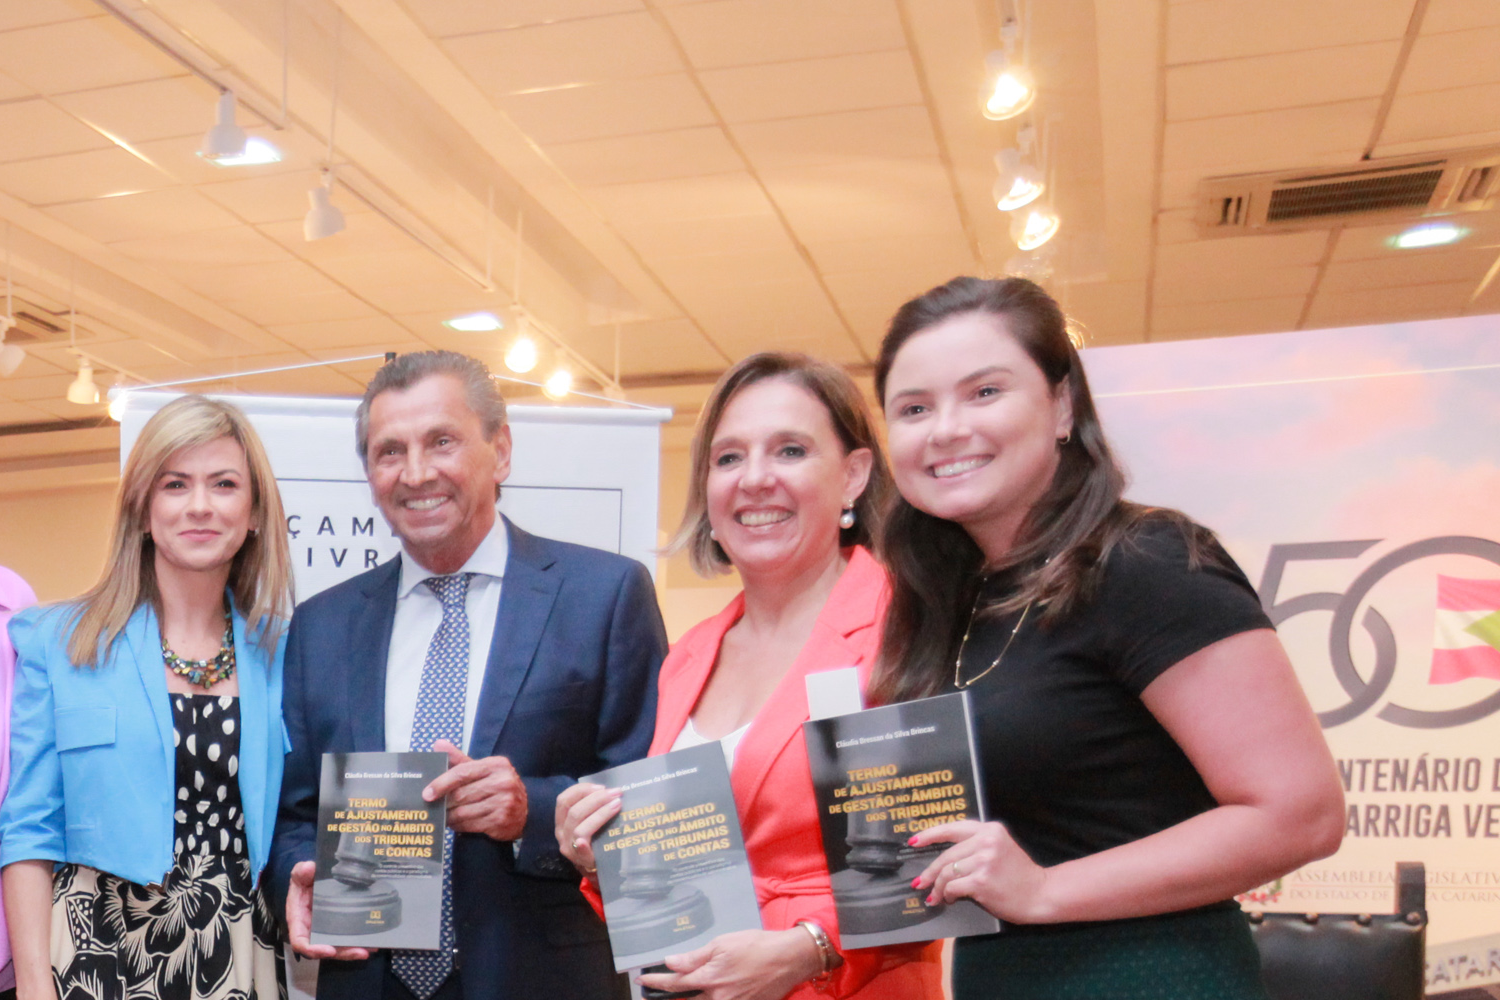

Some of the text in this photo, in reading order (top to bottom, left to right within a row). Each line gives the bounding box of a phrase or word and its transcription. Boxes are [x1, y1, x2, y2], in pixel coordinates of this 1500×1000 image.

[847, 764, 898, 782] TERMO
[834, 770, 953, 798] DE AJUSTAMENTO
[348, 798, 387, 808] TERMO
[829, 805, 842, 814] DE
[843, 794, 894, 813] GESTÃO
[912, 784, 965, 802] ÂMBITO
[347, 810, 428, 820] AJUSTAMENTO
[609, 802, 716, 837] DE AJUSTAMENTO
[620, 802, 666, 822] TERMO
[889, 798, 967, 821] TRIBUNAIS
[339, 821, 379, 833] GESTÃO
[393, 822, 434, 833] ÂMBITO
[604, 842, 616, 851] DE
[617, 829, 664, 849] GESTÃO
[680, 813, 726, 833] ÂMBITO
[893, 824, 907, 833] DE
[373, 835, 433, 845] TRIBUNAIS
[659, 825, 729, 851] TRIBUNAIS
[386, 847, 432, 857] CONTAS
[664, 837, 730, 861] DE CONTAS
